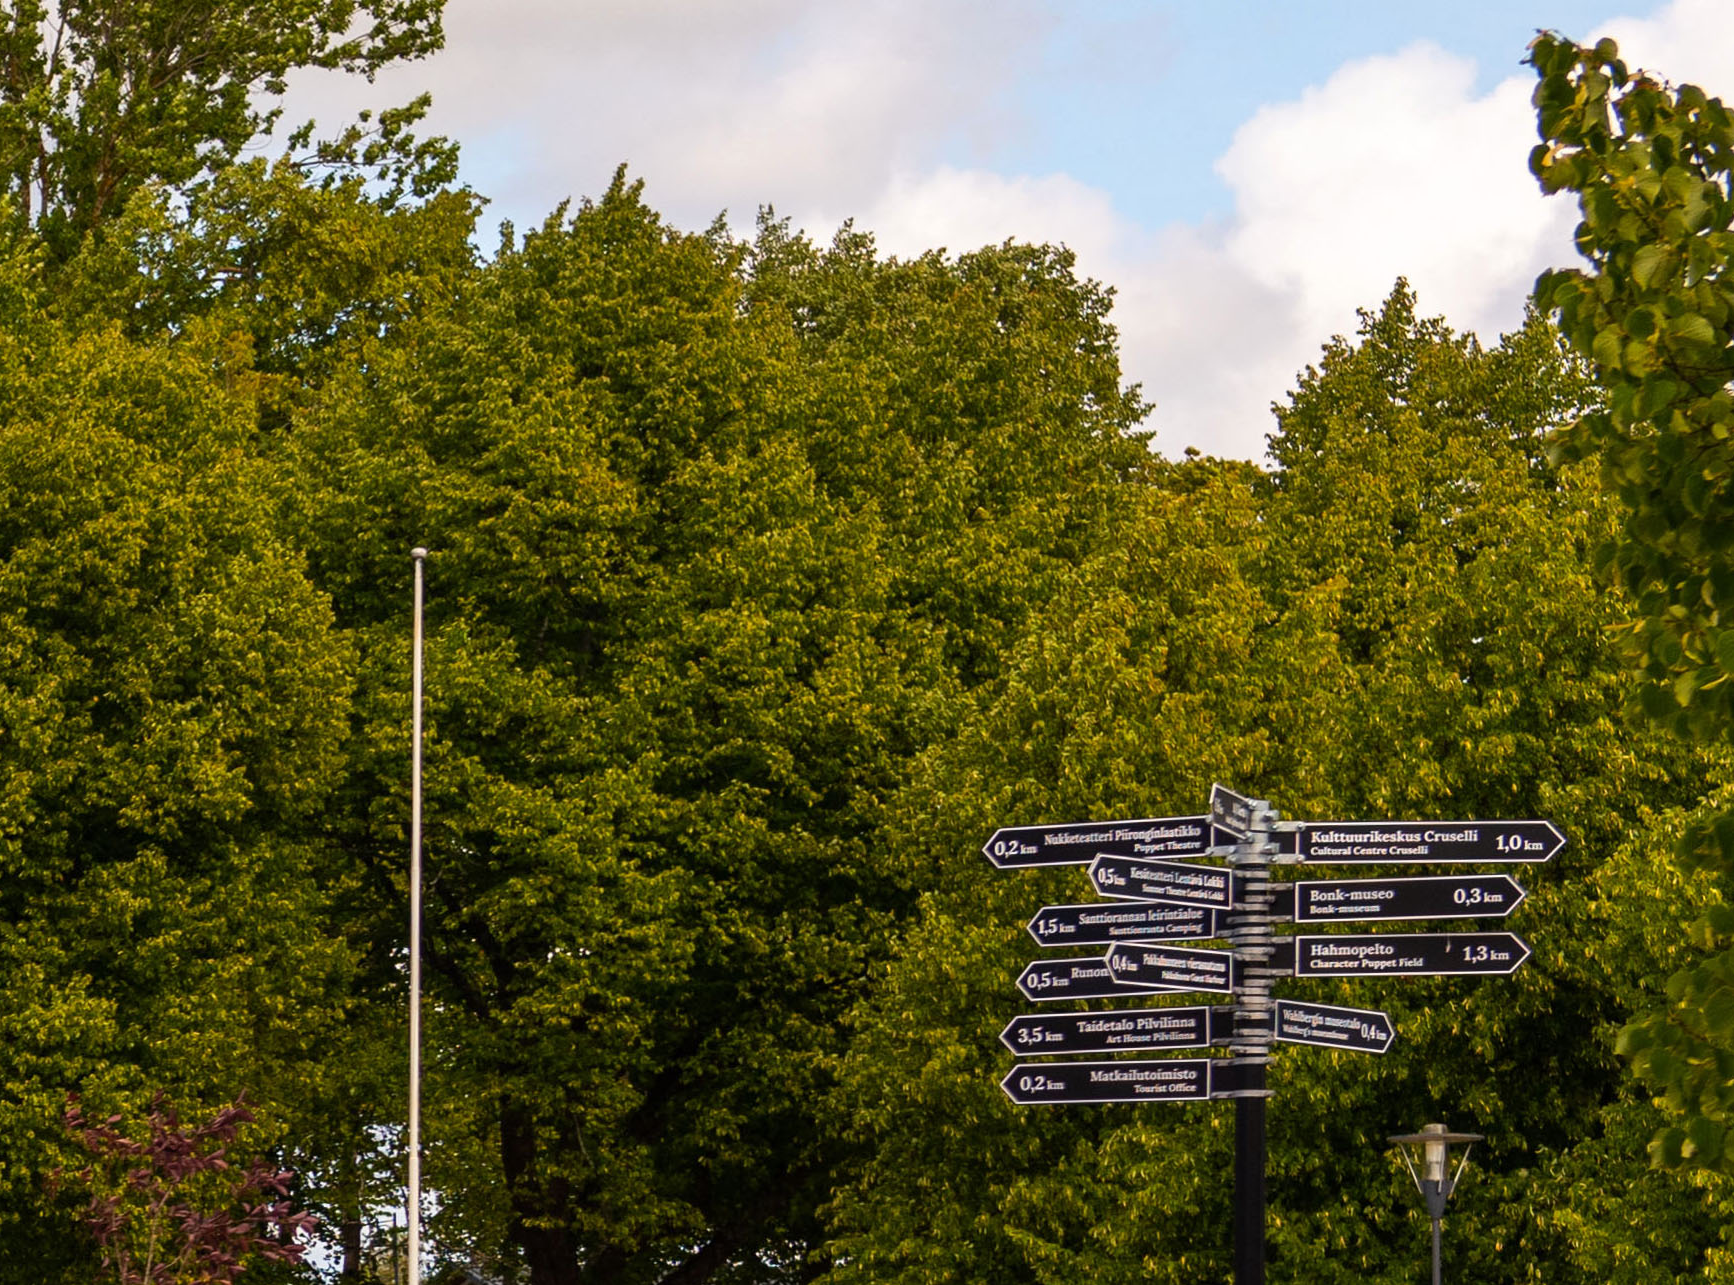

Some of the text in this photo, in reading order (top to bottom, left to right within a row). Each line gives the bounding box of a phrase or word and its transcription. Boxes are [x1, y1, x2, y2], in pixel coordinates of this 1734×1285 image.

[1044, 826, 1202, 846] Nukketeatteri Piironginlaatikko
[1311, 830, 1478, 844] Kulttuurikeskus Cruselli
[1495, 834, 1543, 853] 1,0 km
[994, 840, 1038, 859] 0,2 km
[1134, 841, 1202, 854] Puppet Theatre
[1310, 845, 1429, 856] Cultural Centre Cruselli
[1098, 867, 1114, 886] 0,5
[1310, 889, 1395, 902] Bonk-museo
[1453, 887, 1503, 907] 0,3 km
[1078, 908, 1205, 925] Santtiorannan leirintäalue
[1310, 904, 1381, 914] Bonk-museum
[1037, 918, 1076, 937] 1,5 km
[1166, 922, 1204, 934] Camping
[1310, 943, 1395, 959] Hahmopelto
[1462, 945, 1510, 964] 1,3 km
[1112, 954, 1127, 973] 0,4
[1310, 957, 1424, 970] Character Puppet Field
[1027, 972, 1070, 990] 0,5 km
[1071, 967, 1111, 979] Runon
[1076, 1016, 1196, 1033] Taidetalo Pilvilinna
[1361, 1023, 1376, 1042] 0,4
[1017, 1026, 1064, 1046] 3,5 km
[1106, 1031, 1197, 1044] Art House Pilvilinna
[1090, 1068, 1197, 1082] Matkailutoimisto
[1019, 1075, 1065, 1095] 0,2 km
[1133, 1082, 1197, 1093] Tourist Office
